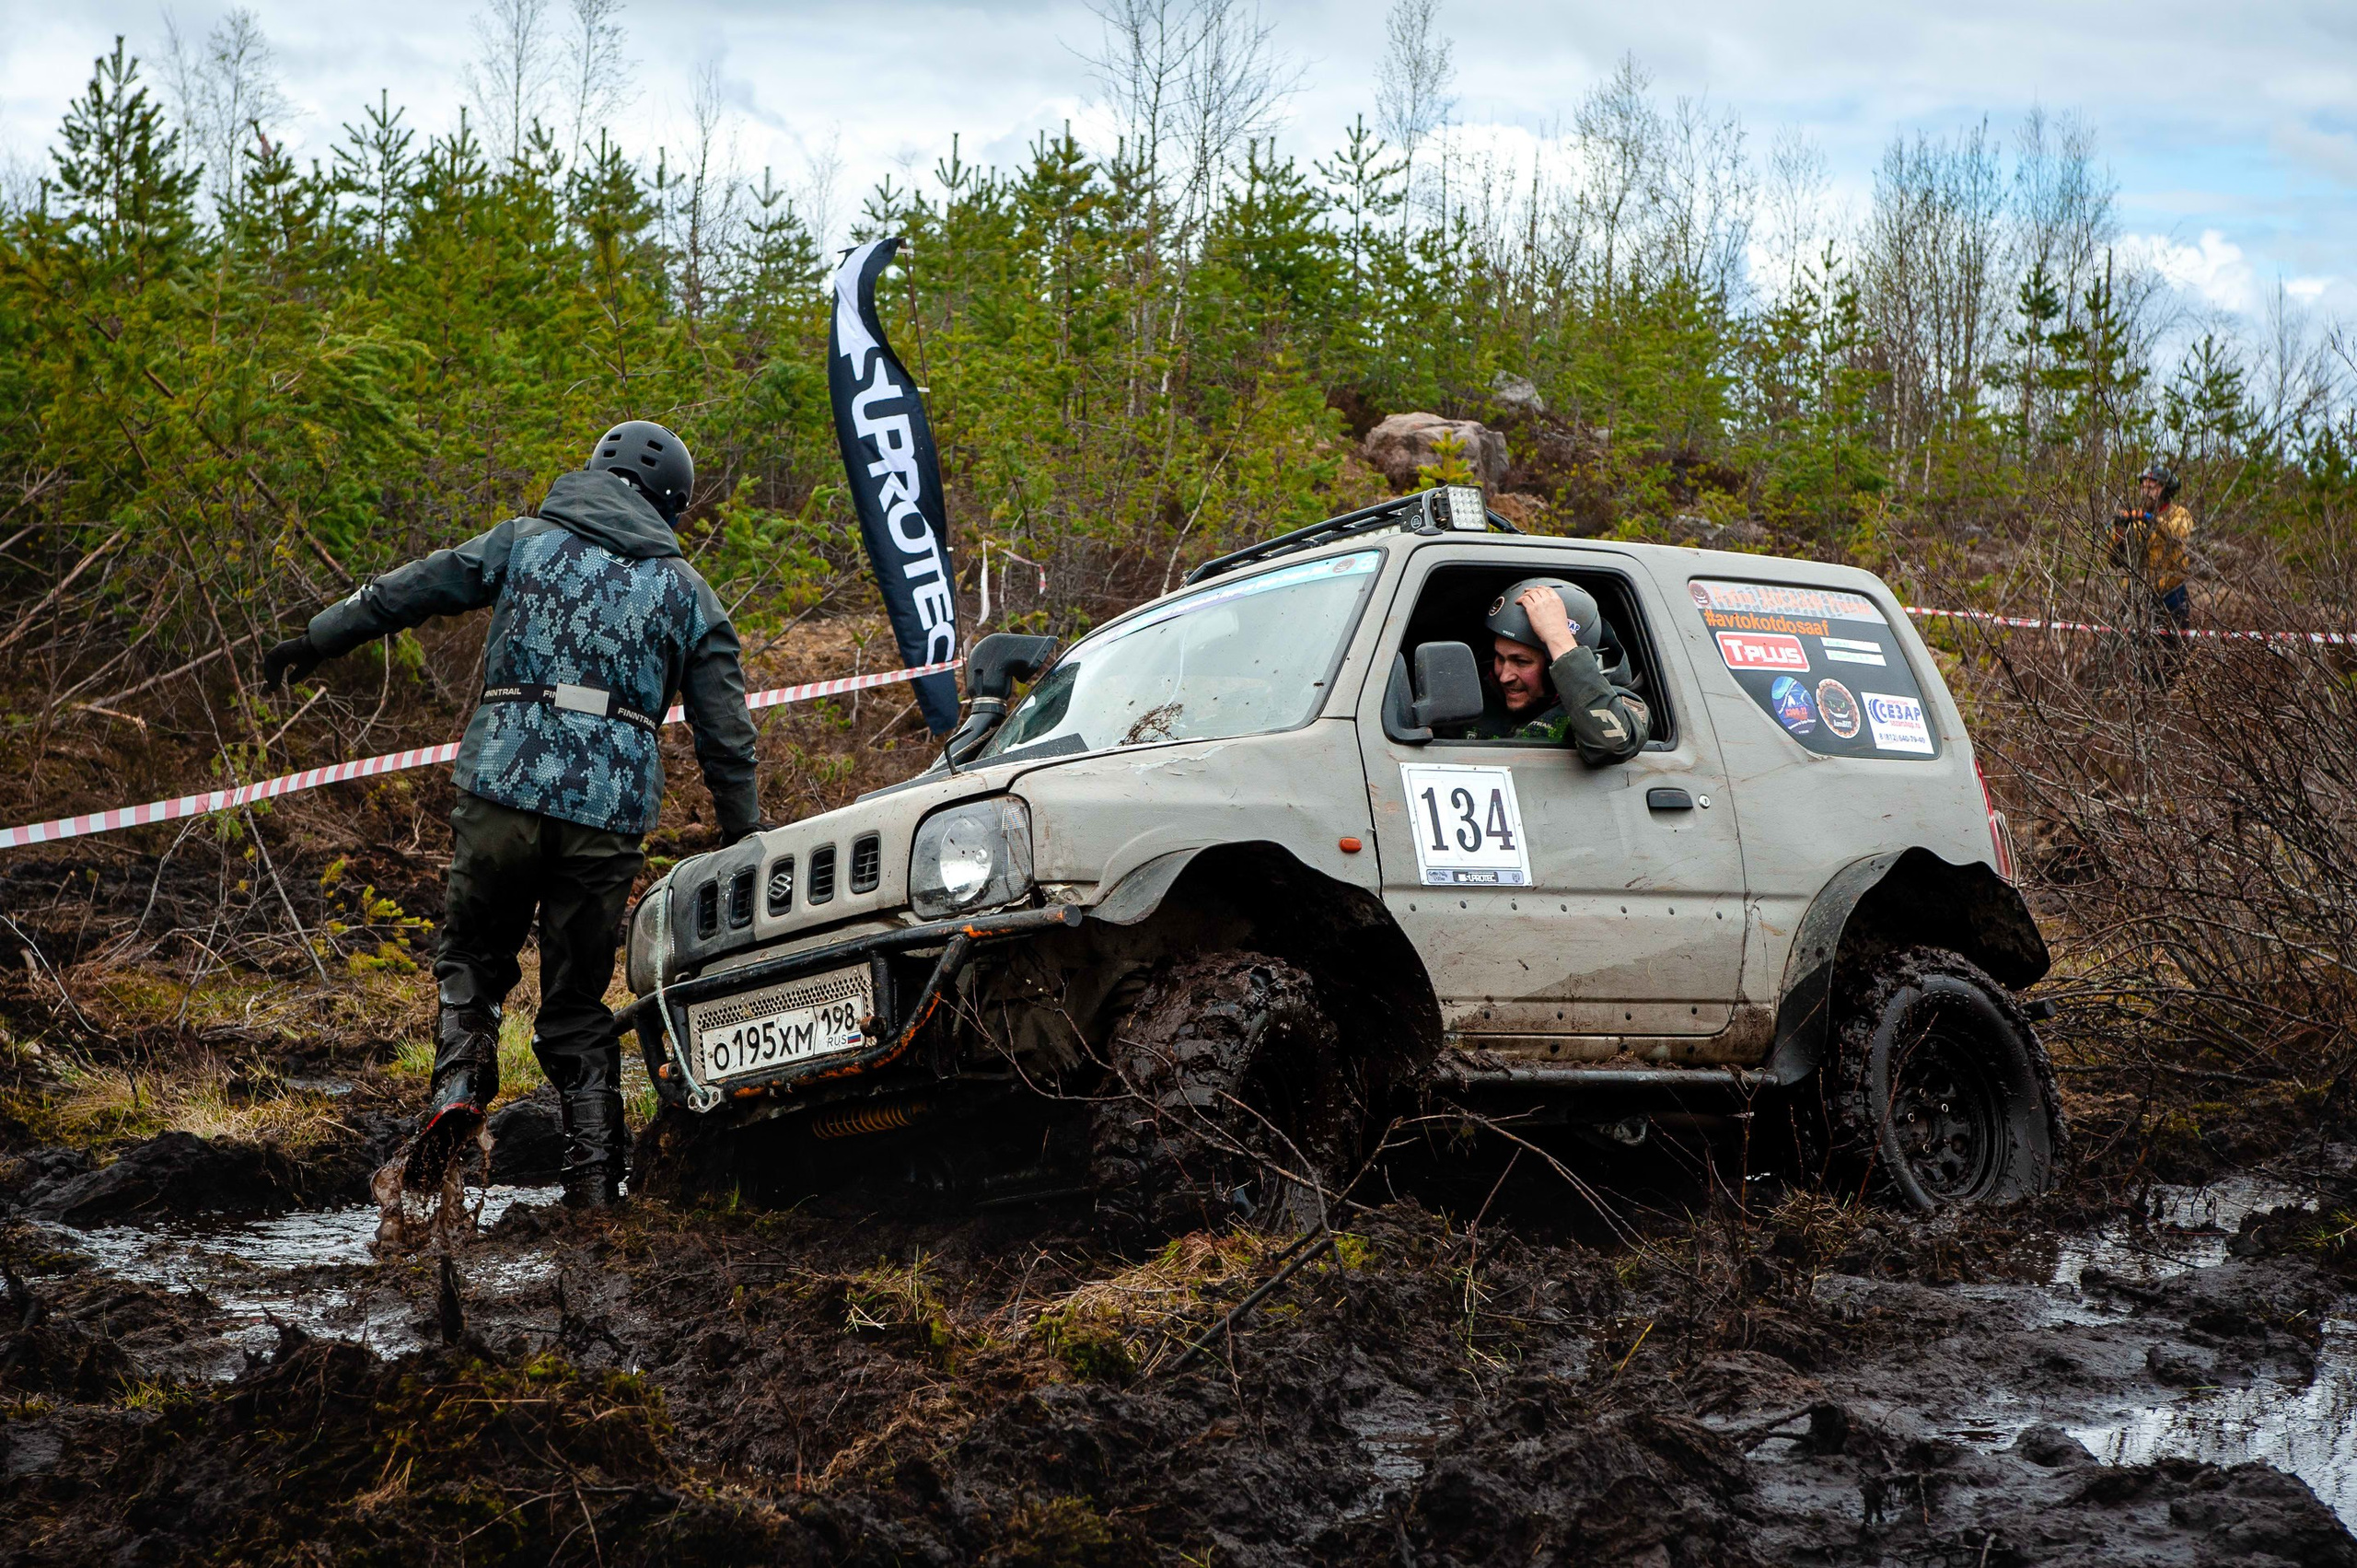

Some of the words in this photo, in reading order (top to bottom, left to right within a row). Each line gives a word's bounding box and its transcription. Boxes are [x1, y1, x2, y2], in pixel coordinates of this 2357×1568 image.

[1705, 610, 1829, 636] #avtokotdosaaf
[1421, 786, 1515, 853] 134
[821, 1002, 855, 1035] 198
[827, 1034, 847, 1048] RUS
